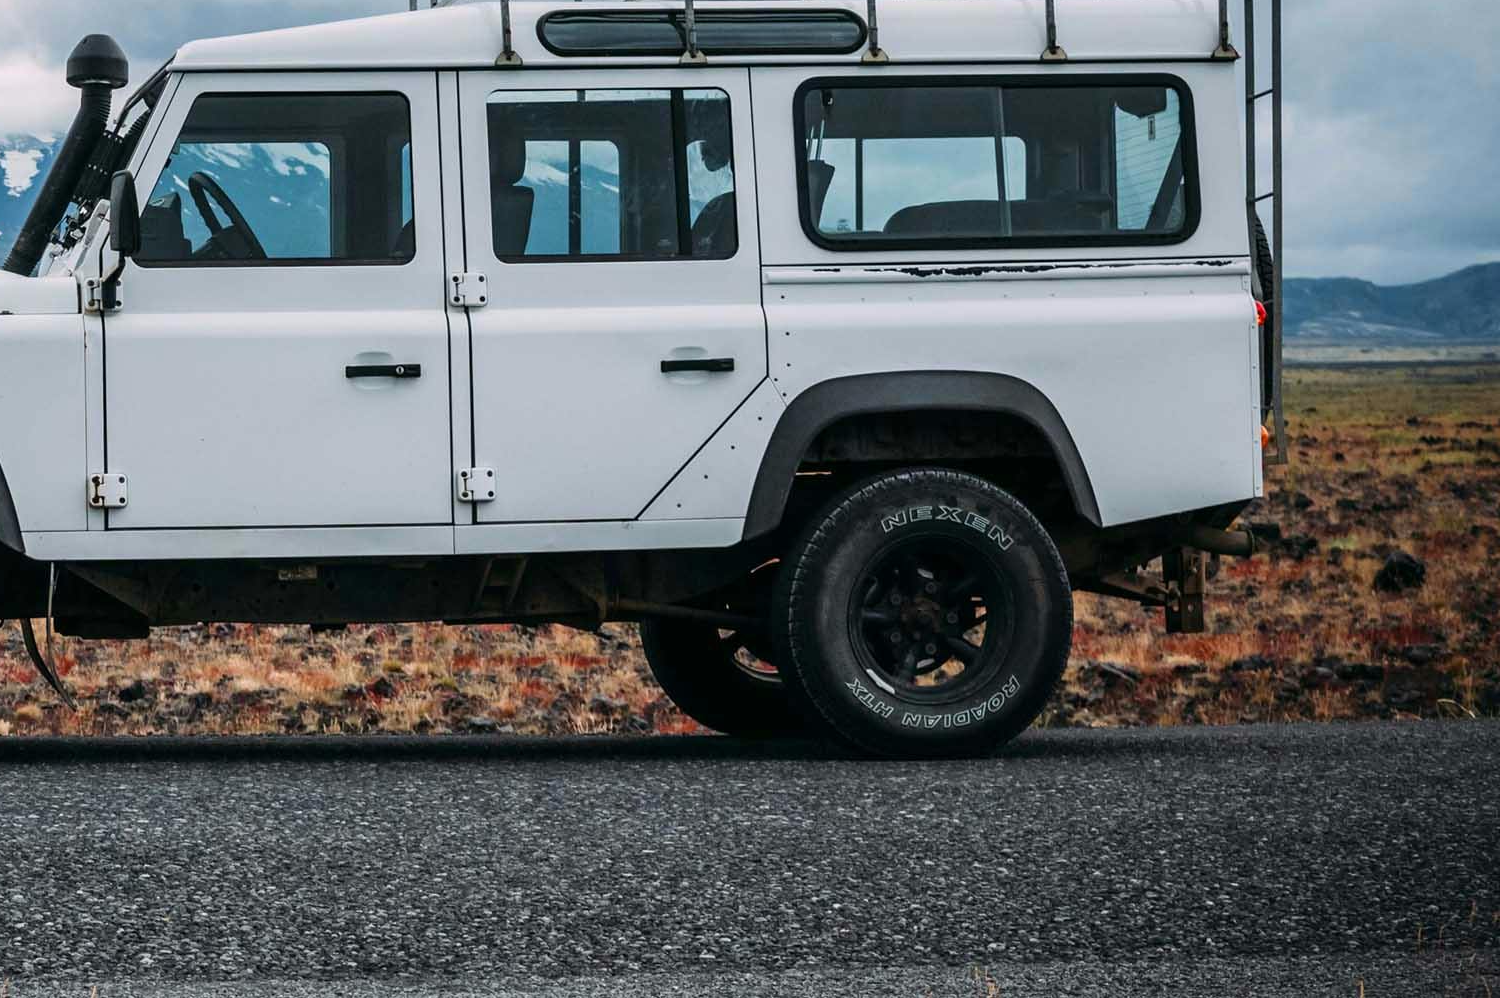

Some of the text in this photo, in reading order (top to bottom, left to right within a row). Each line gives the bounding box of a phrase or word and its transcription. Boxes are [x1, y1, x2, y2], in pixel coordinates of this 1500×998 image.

[881, 505, 1014, 551] NEXEN
[844, 674, 1021, 729] ROADIAN HTX
